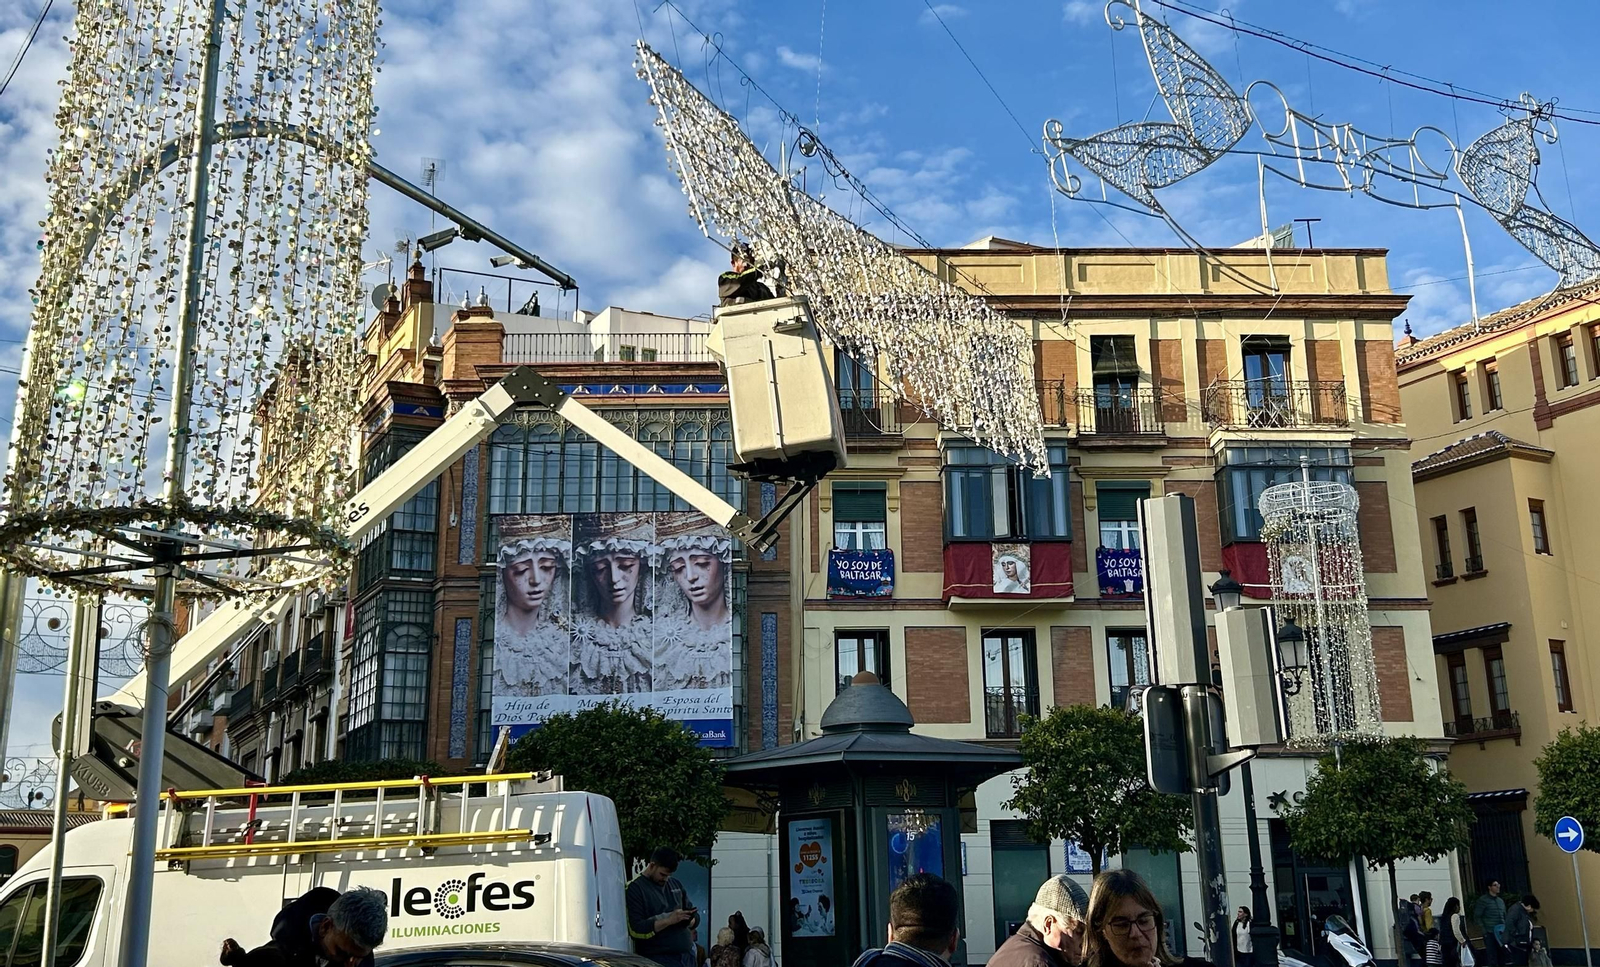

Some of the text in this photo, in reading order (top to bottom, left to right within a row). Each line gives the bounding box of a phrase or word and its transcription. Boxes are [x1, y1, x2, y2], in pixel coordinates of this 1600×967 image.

[836, 560, 882, 570] YO SOY DE
[1103, 559, 1117, 568] YO
[1118, 558, 1137, 567] SOY
[840, 570, 881, 580] BALTASAR
[1107, 568, 1142, 578] BALTASA
[663, 693, 723, 706] Esposa del
[505, 699, 550, 714] Hija de
[702, 704, 733, 714] Santo
[495, 709, 556, 723] Dios Pad
[72, 763, 111, 797] KLUBB
[391, 872, 535, 920] lecfes
[391, 922, 501, 938] ILUMINACIONES
